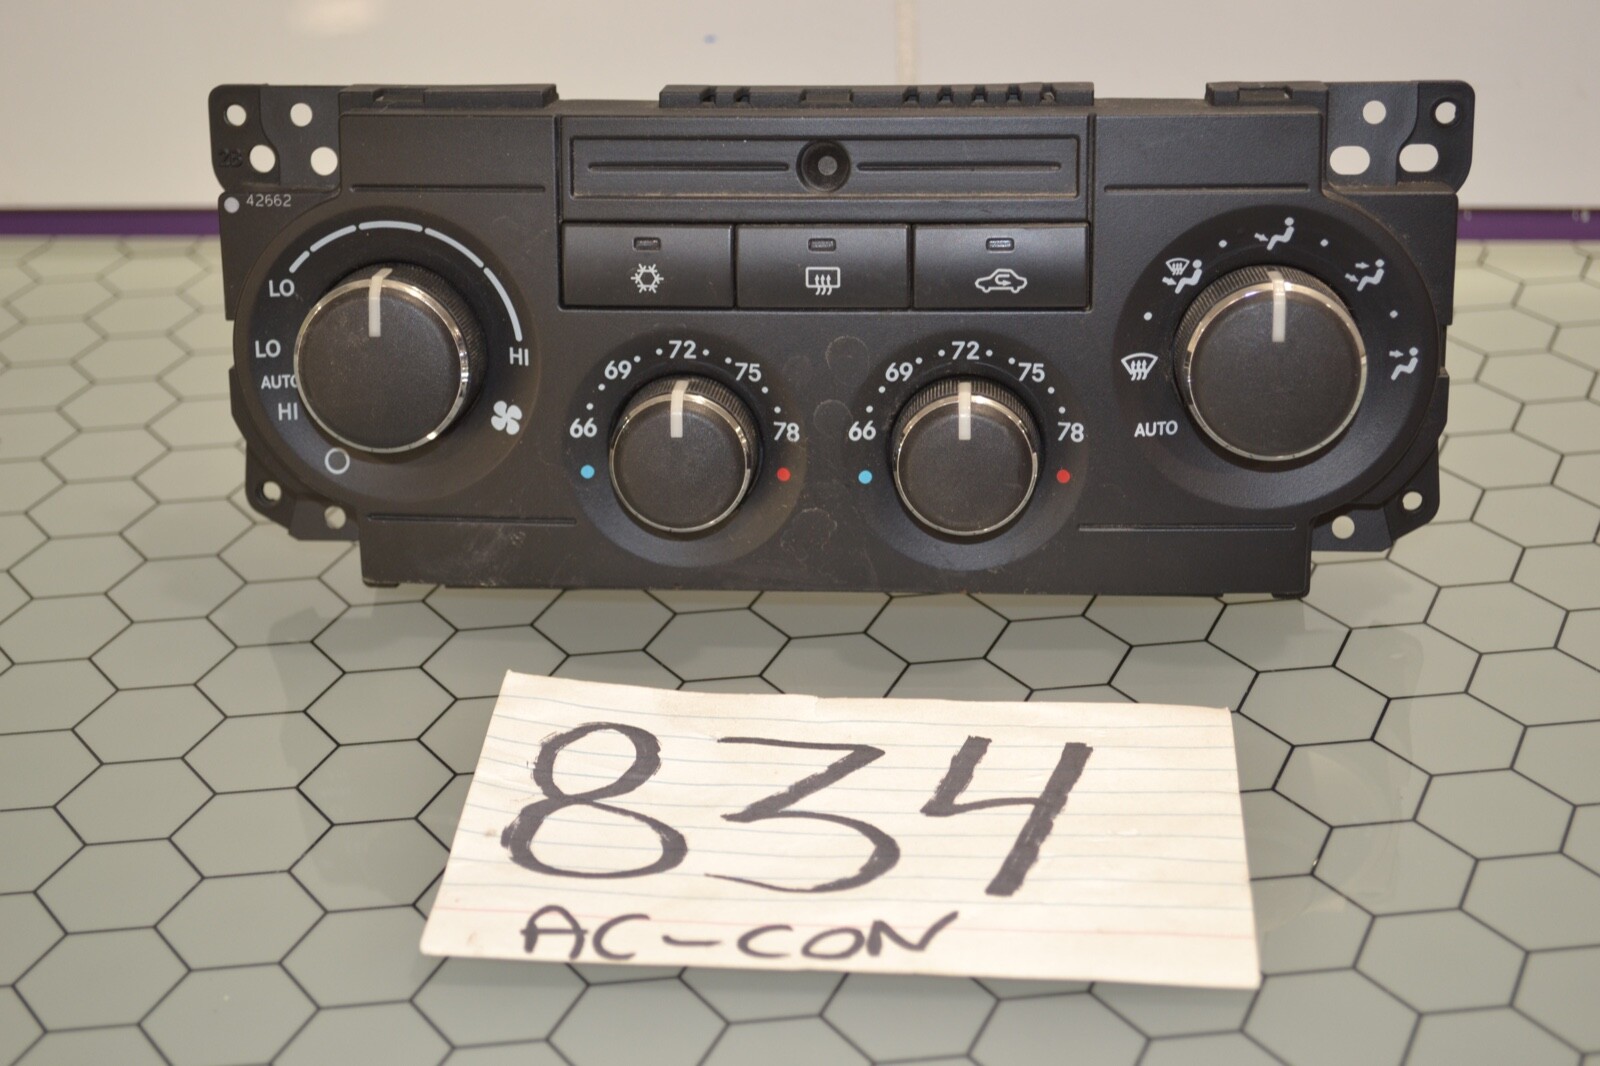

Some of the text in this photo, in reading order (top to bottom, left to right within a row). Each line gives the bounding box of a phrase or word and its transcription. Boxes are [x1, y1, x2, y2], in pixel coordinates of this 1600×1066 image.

[246, 194, 292, 207] 42662
[268, 278, 295, 298] LO
[254, 339, 282, 358] LO
[509, 346, 529, 367] HI
[668, 339, 697, 360] 72
[951, 340, 980, 361] 72
[604, 359, 632, 380] 69
[734, 362, 762, 382] 75
[885, 361, 914, 382] 69
[1018, 362, 1046, 382] 75
[277, 402, 298, 421] HI
[569, 417, 598, 439] 66
[773, 421, 801, 443] 78
[848, 420, 877, 442] 66
[1057, 421, 1085, 443] 78
[1134, 419, 1179, 438] AUTO
[501, 722, 1094, 897] 834
